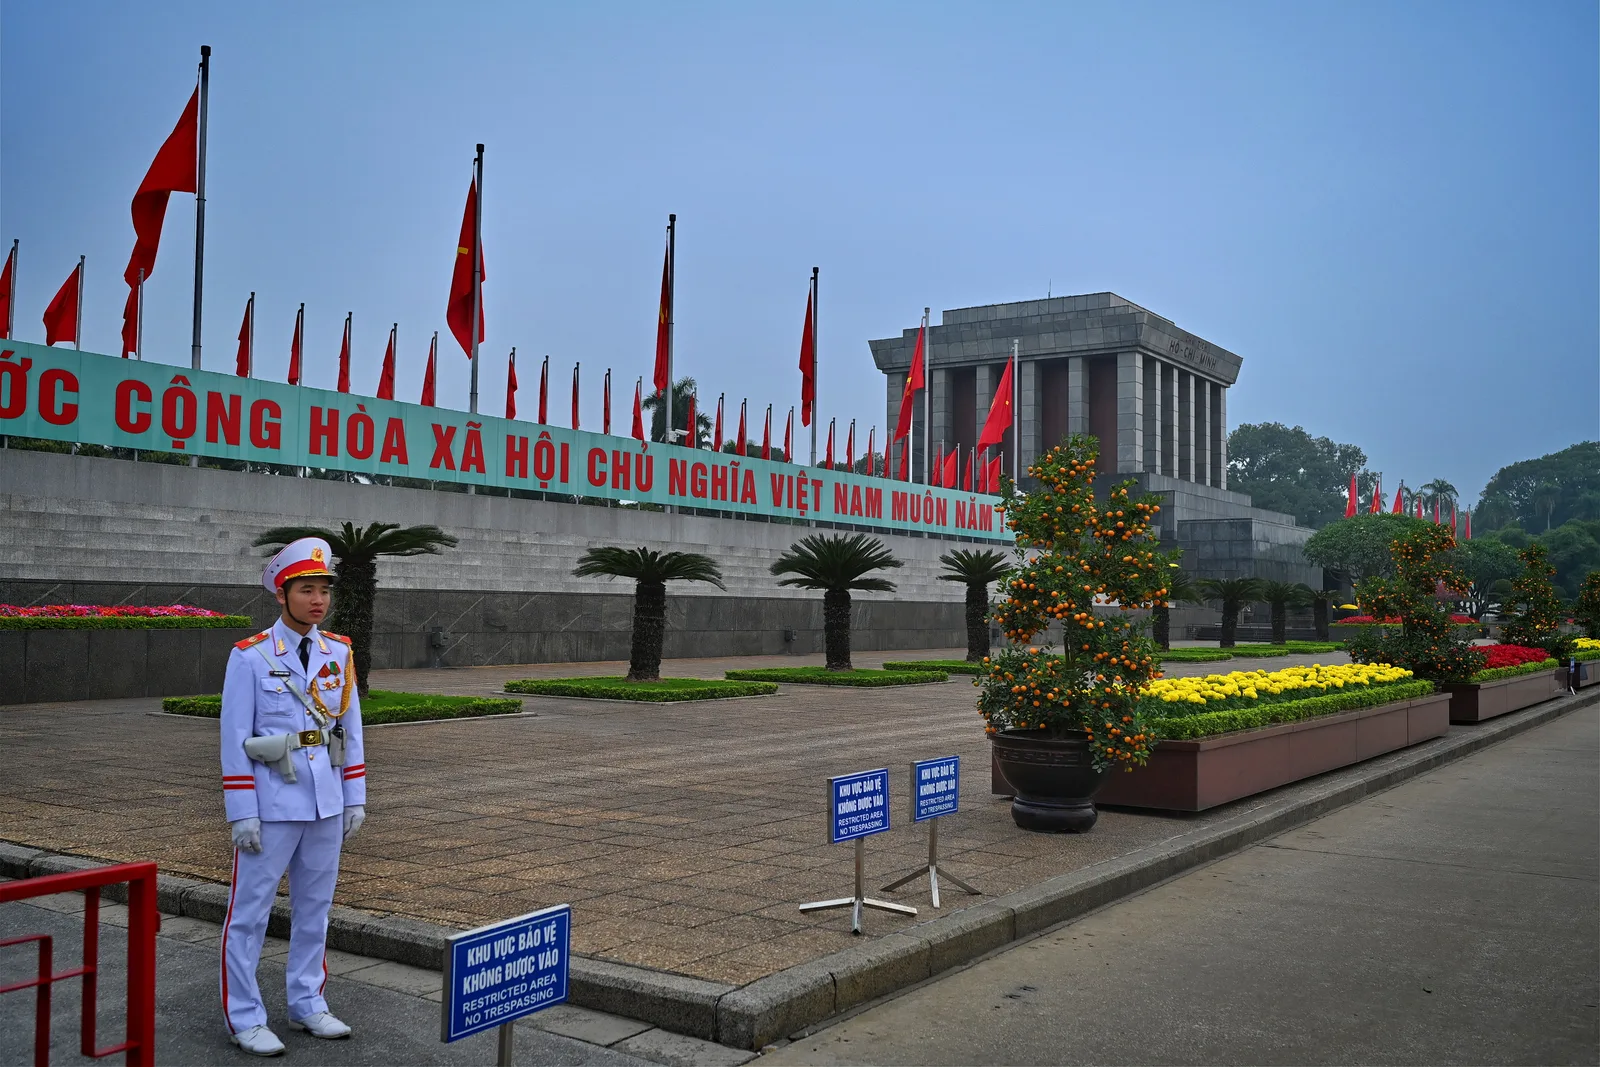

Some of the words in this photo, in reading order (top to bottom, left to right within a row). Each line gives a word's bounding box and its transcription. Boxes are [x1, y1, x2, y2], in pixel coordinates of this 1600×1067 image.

[115, 374, 281, 449] CỘNG
[309, 404, 409, 465] HÒA
[429, 420, 486, 474] XÃ
[505, 431, 570, 489] HỘI
[587, 441, 653, 492] CHỦ
[669, 458, 757, 505] NGHĨA
[770, 470, 823, 517] VIỆT
[834, 482, 882, 519] NAM
[892, 489, 947, 527] MUÔN
[955, 496, 993, 532] NĂM
[840, 784, 850, 797] KHU
[839, 814, 869, 826] RESTRICTED
[870, 811, 883, 819] AREA
[849, 820, 882, 833] TRESPASSING
[467, 943, 490, 968] KHU
[494, 935, 516, 960] VỰC
[518, 926, 540, 952] BẢO
[544, 921, 557, 946] VỆ
[463, 967, 502, 995] KHÔNG
[505, 956, 535, 980] ĐƯỢC
[538, 948, 559, 971] VÀO
[462, 982, 528, 1014] RESTRICTED
[530, 974, 557, 991] AREA
[465, 1012, 481, 1027] NO
[484, 988, 553, 1018] TRESPASSING
